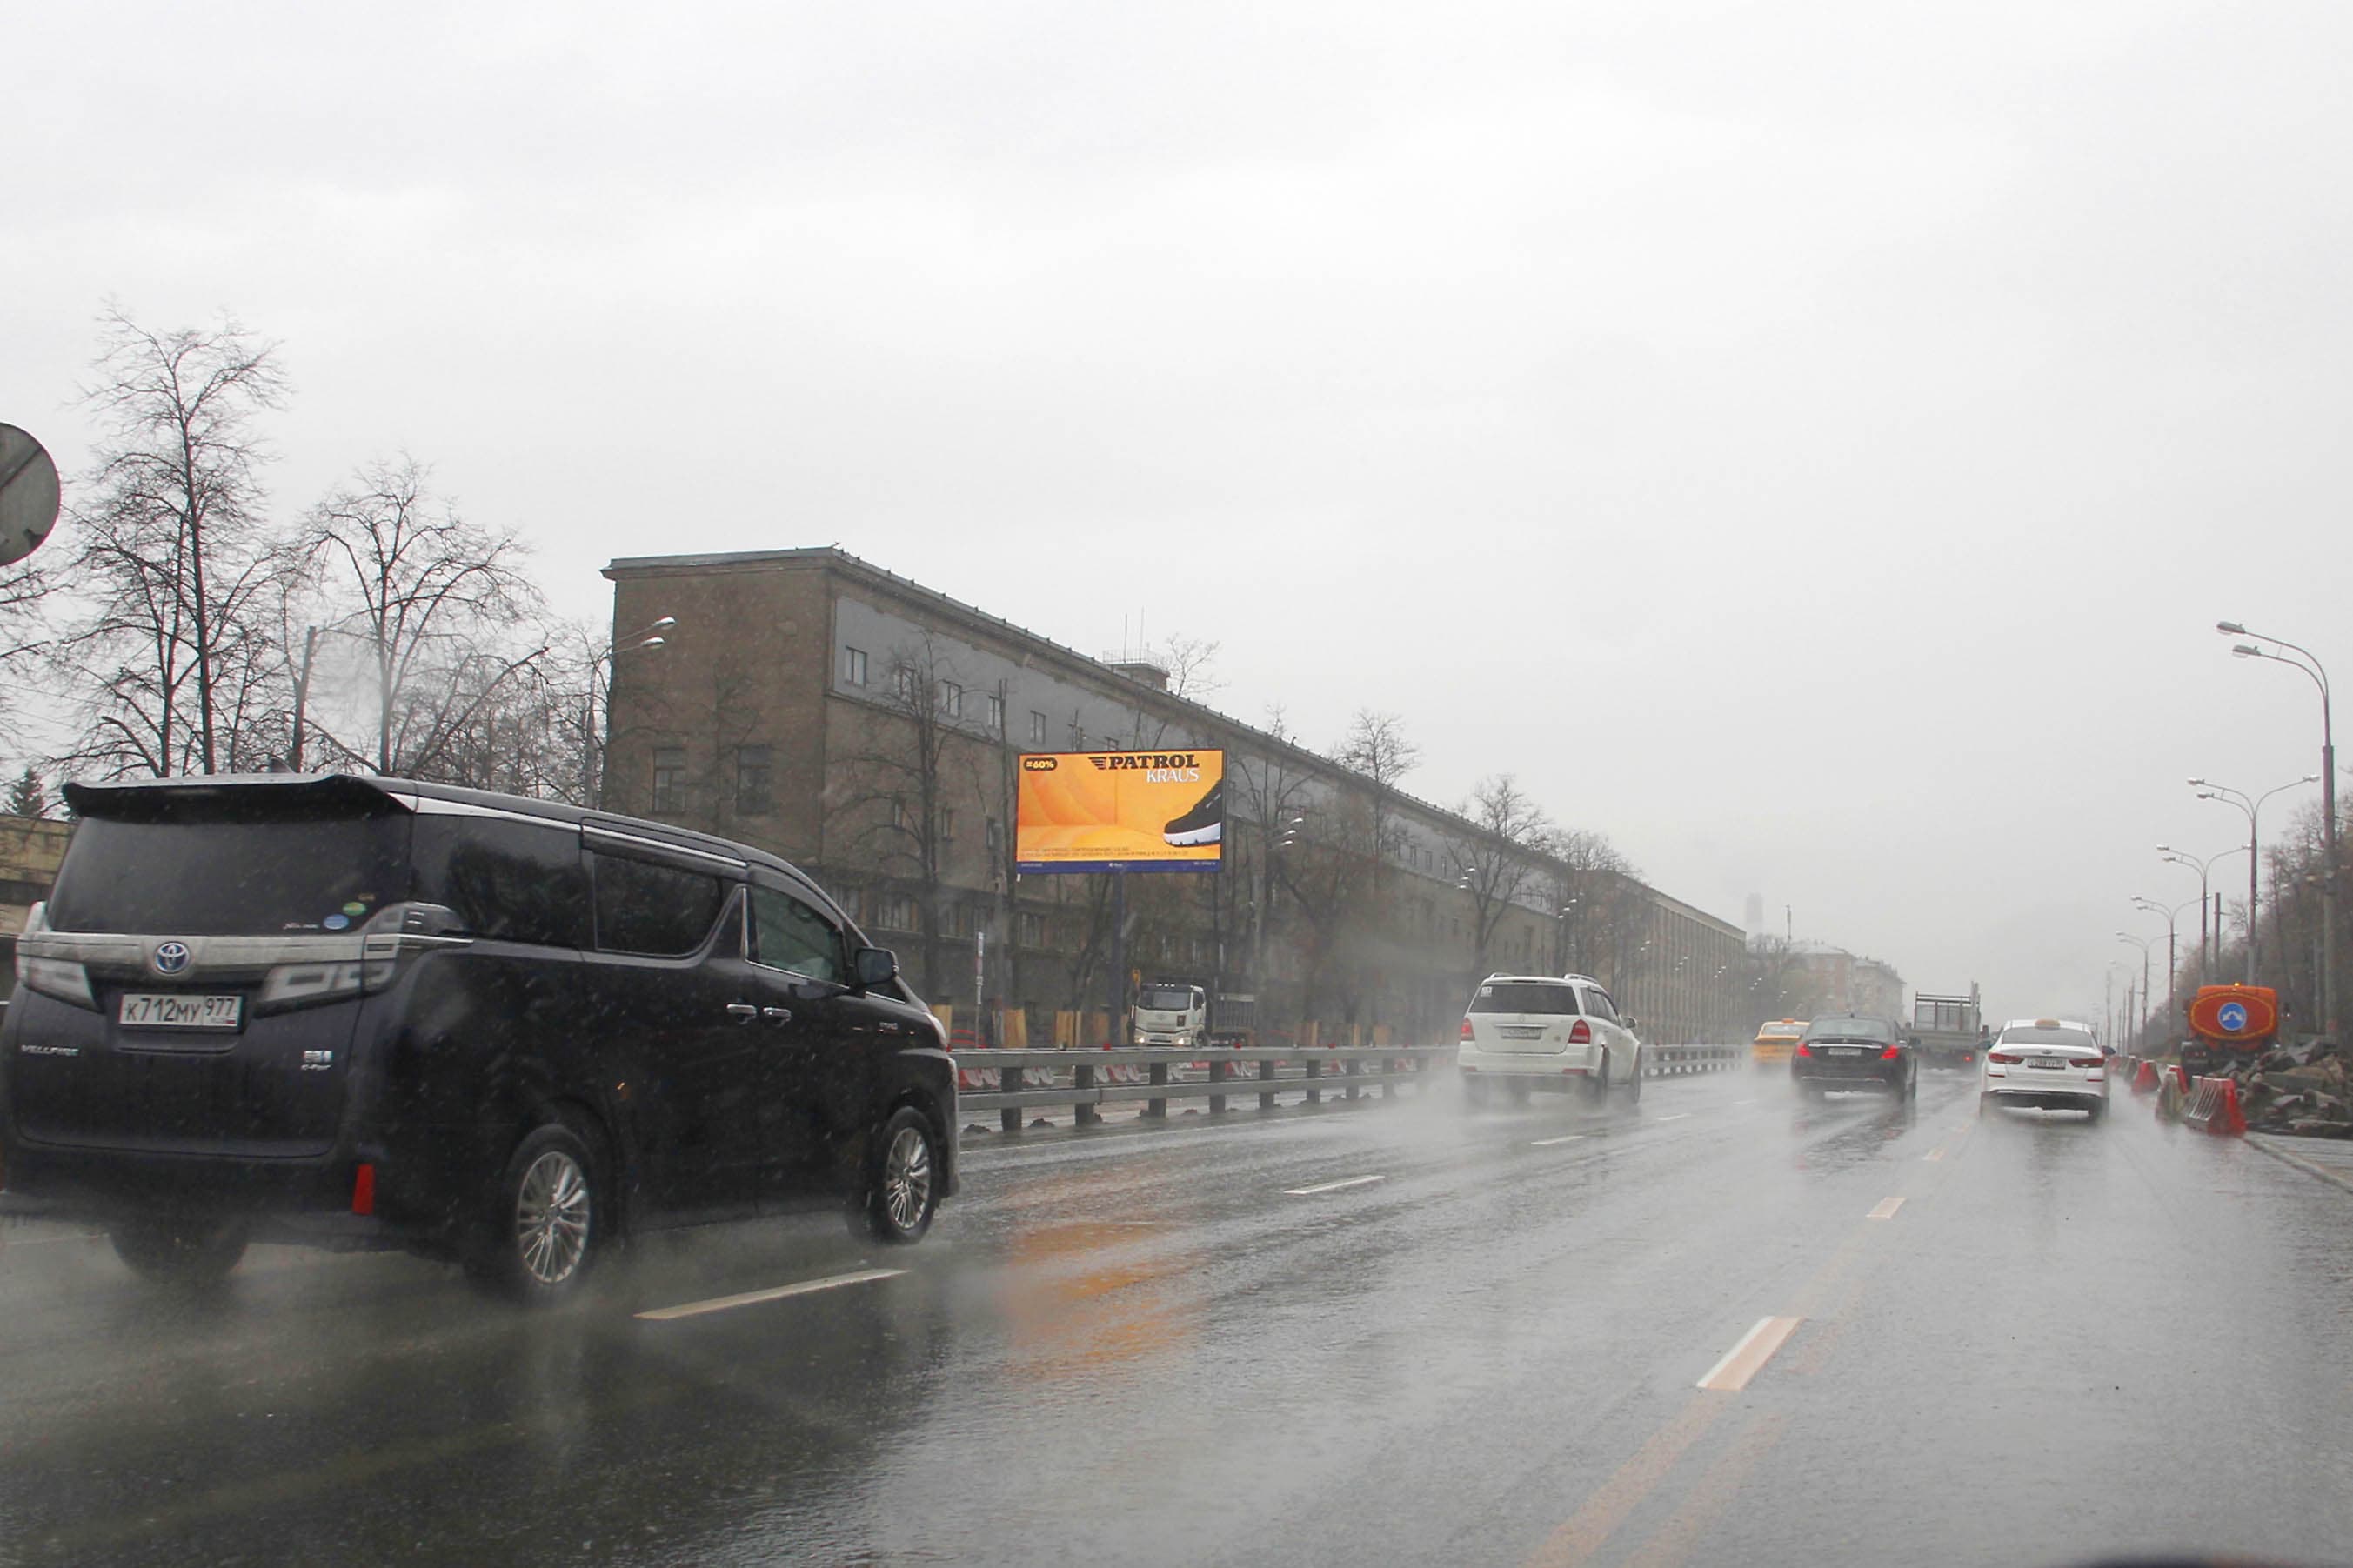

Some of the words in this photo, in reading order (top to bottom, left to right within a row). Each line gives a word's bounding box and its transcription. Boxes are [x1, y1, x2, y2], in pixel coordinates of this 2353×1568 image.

[1108, 754, 1200, 770] PATROL
[1146, 768, 1200, 783] KRAUS
[204, 998, 235, 1017] 977
